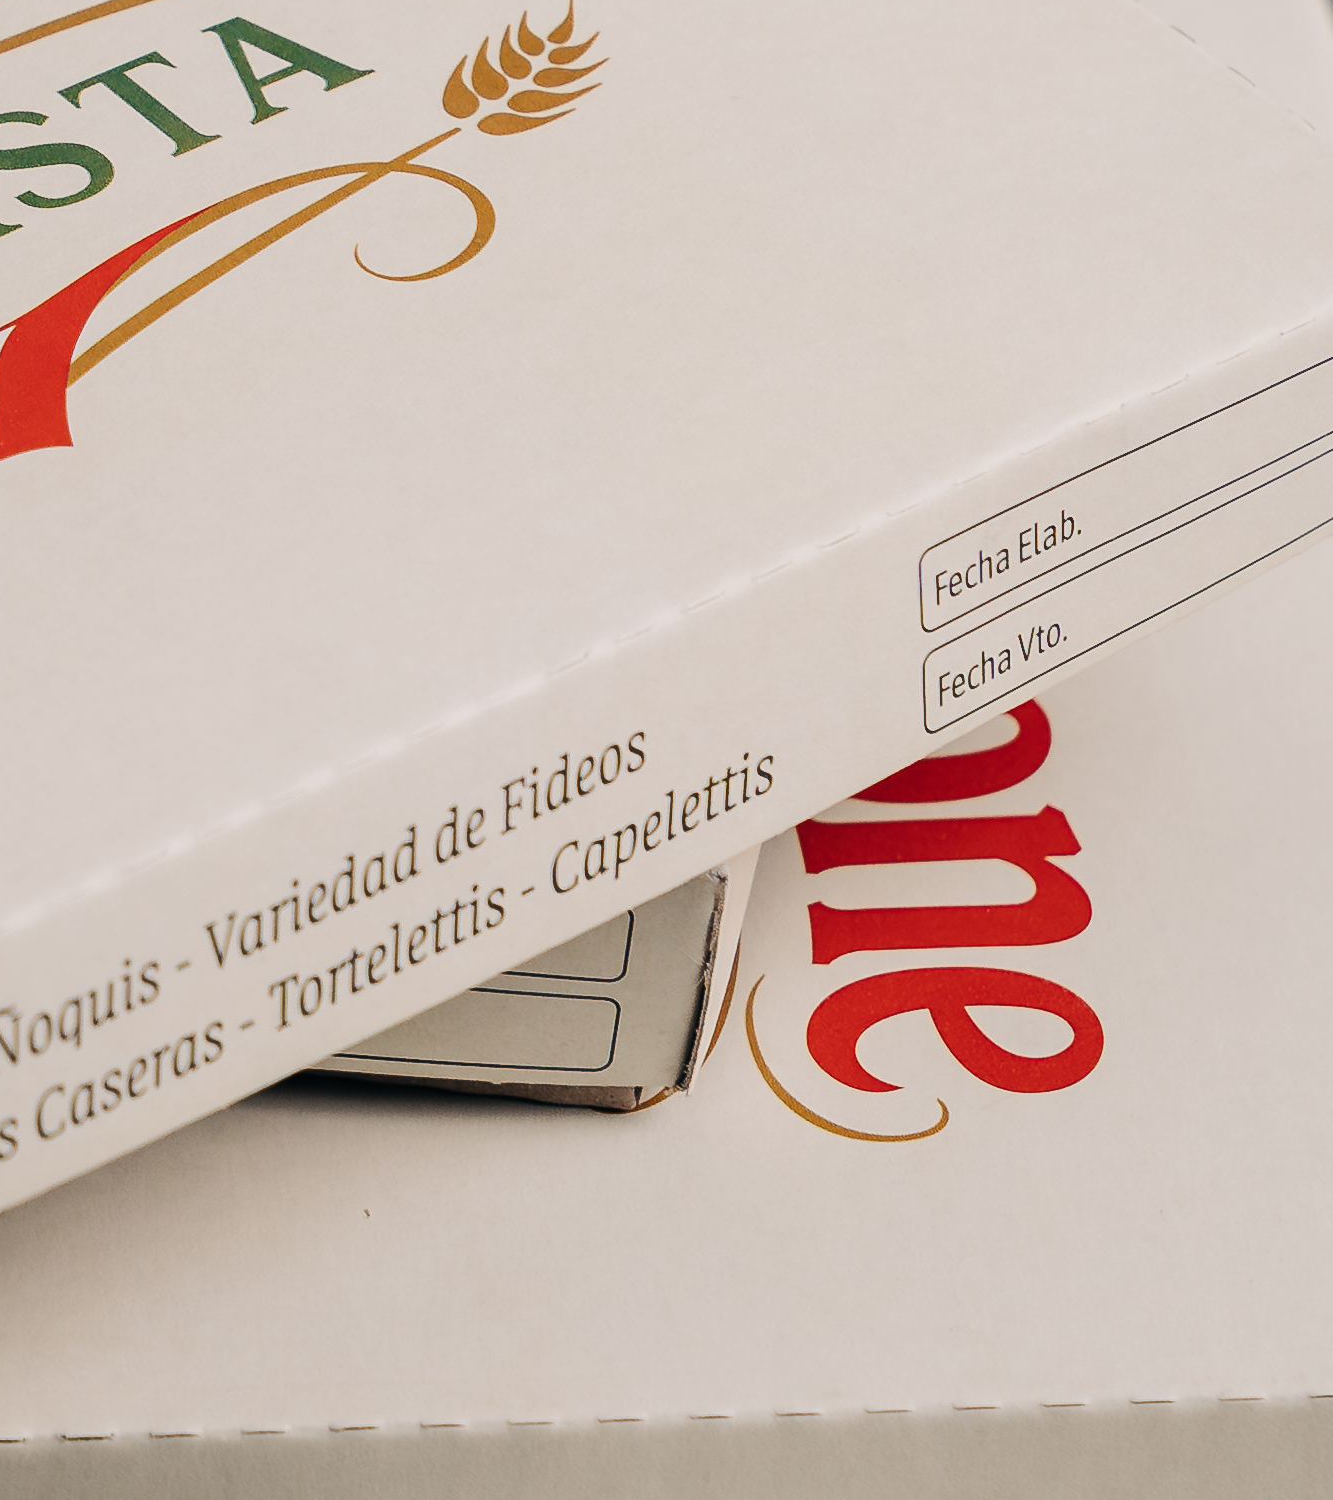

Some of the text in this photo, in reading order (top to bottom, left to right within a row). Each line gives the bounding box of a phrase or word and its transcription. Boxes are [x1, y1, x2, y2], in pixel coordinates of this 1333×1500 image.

[934, 510, 1083, 605] Fecha Elab.
[937, 616, 1069, 708] Fecha Vto.
[205, 825, 420, 972] Variedad
[433, 806, 487, 866] de
[501, 728, 649, 835] Fideos
[33, 1017, 226, 1142] Caseras
[269, 882, 508, 1033] Tortelettis
[552, 752, 776, 894] Capelettis
